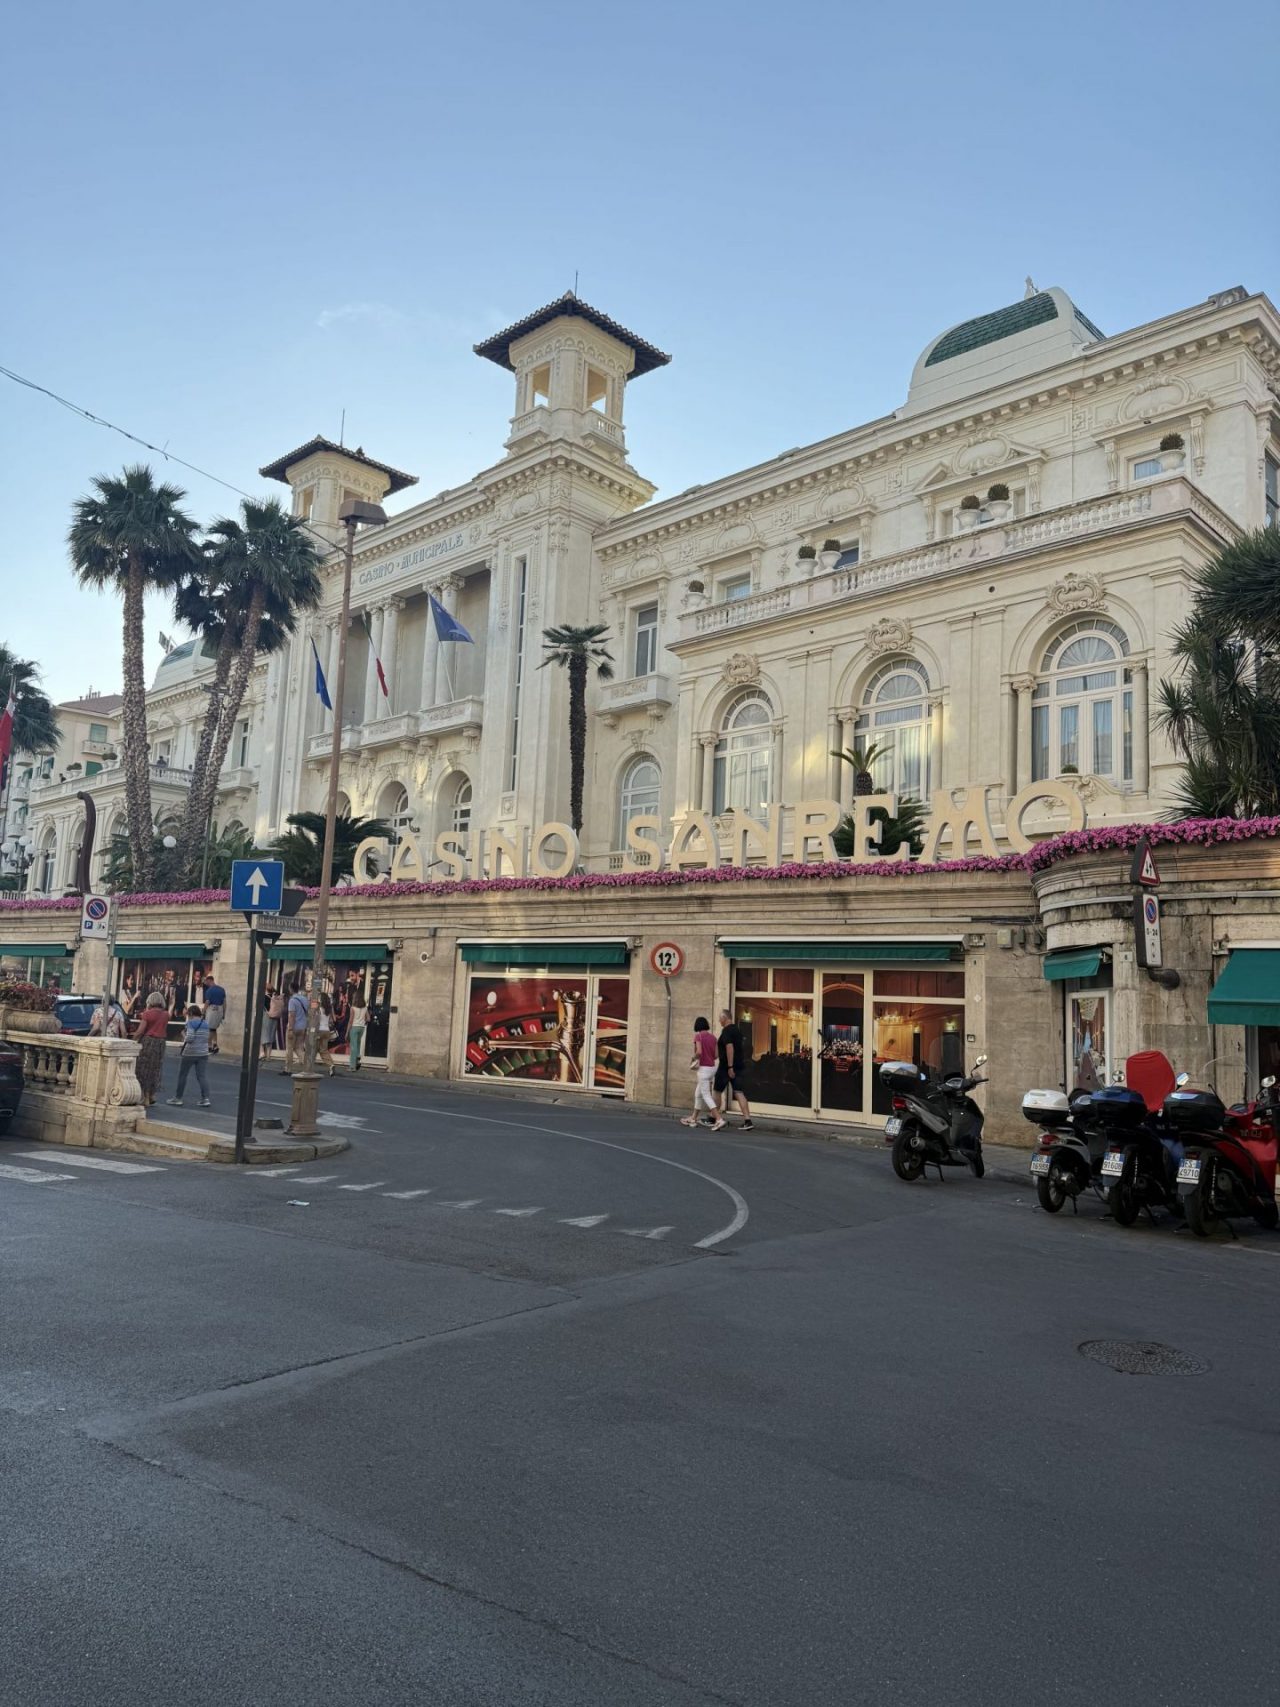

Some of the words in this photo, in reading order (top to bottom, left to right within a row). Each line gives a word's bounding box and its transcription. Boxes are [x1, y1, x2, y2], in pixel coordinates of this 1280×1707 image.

[359, 561, 395, 586] CASINO
[353, 822, 578, 886] CASINO
[624, 780, 1087, 873] SANREMO
